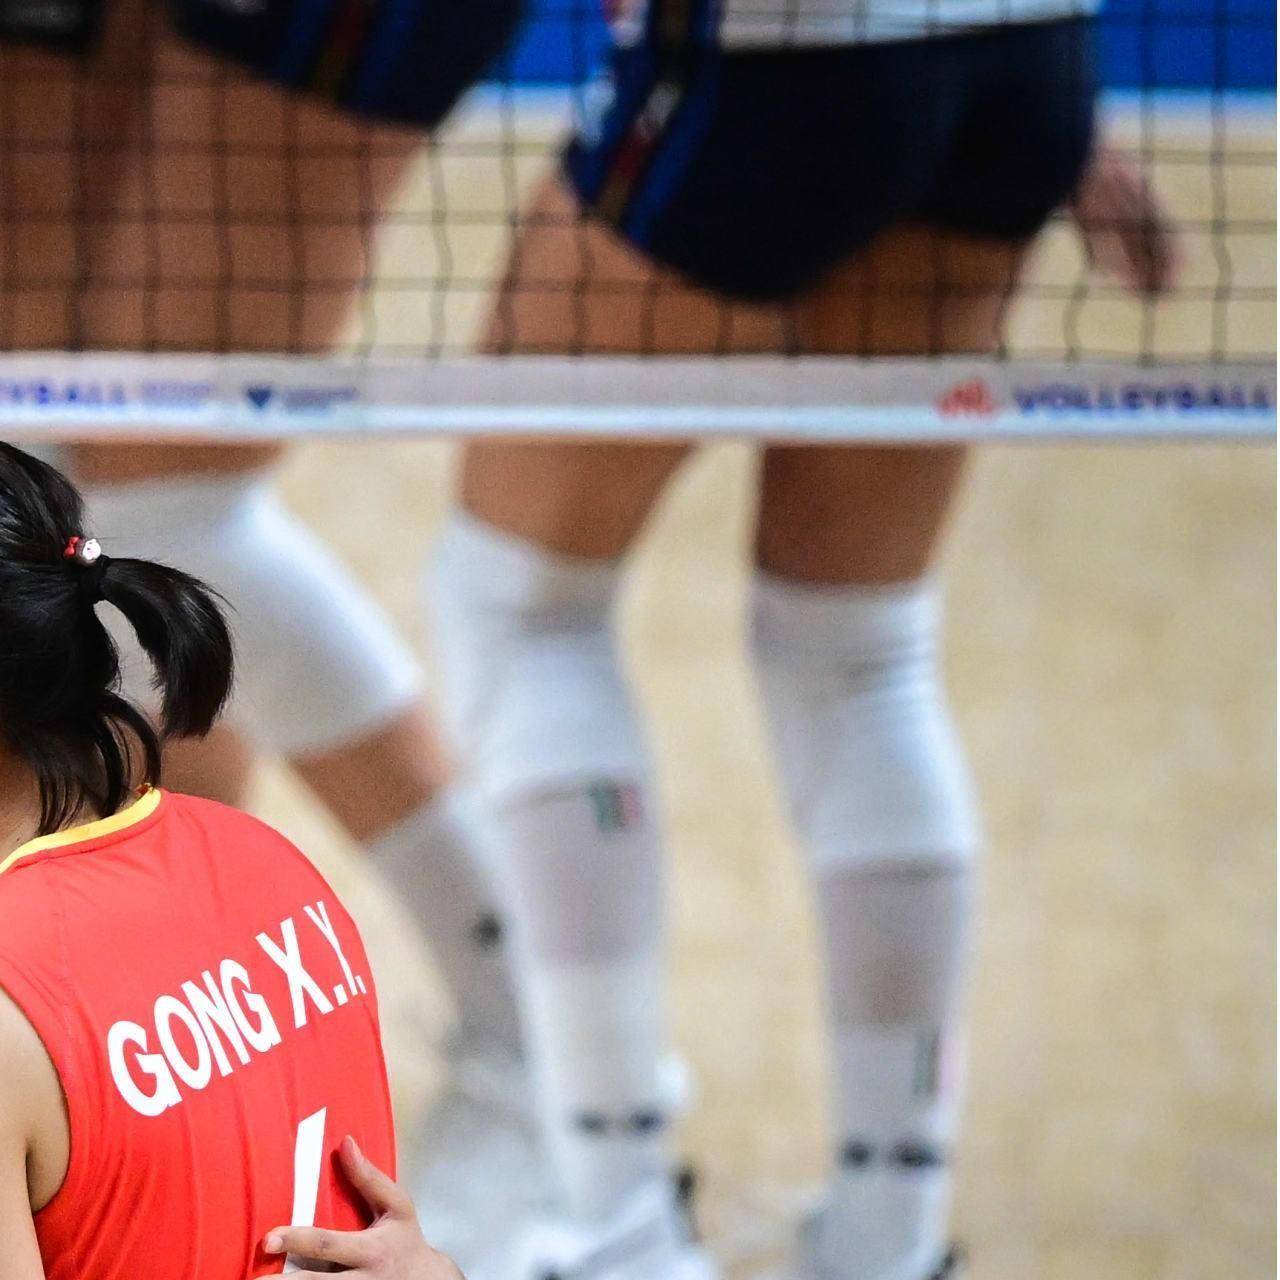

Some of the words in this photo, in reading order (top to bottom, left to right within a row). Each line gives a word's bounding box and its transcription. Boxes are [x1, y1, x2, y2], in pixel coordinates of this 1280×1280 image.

[1012, 381, 1274, 414] VOLLEYBALL
[107, 958, 280, 1117] GONG
[256, 900, 368, 1030] X.Y.
